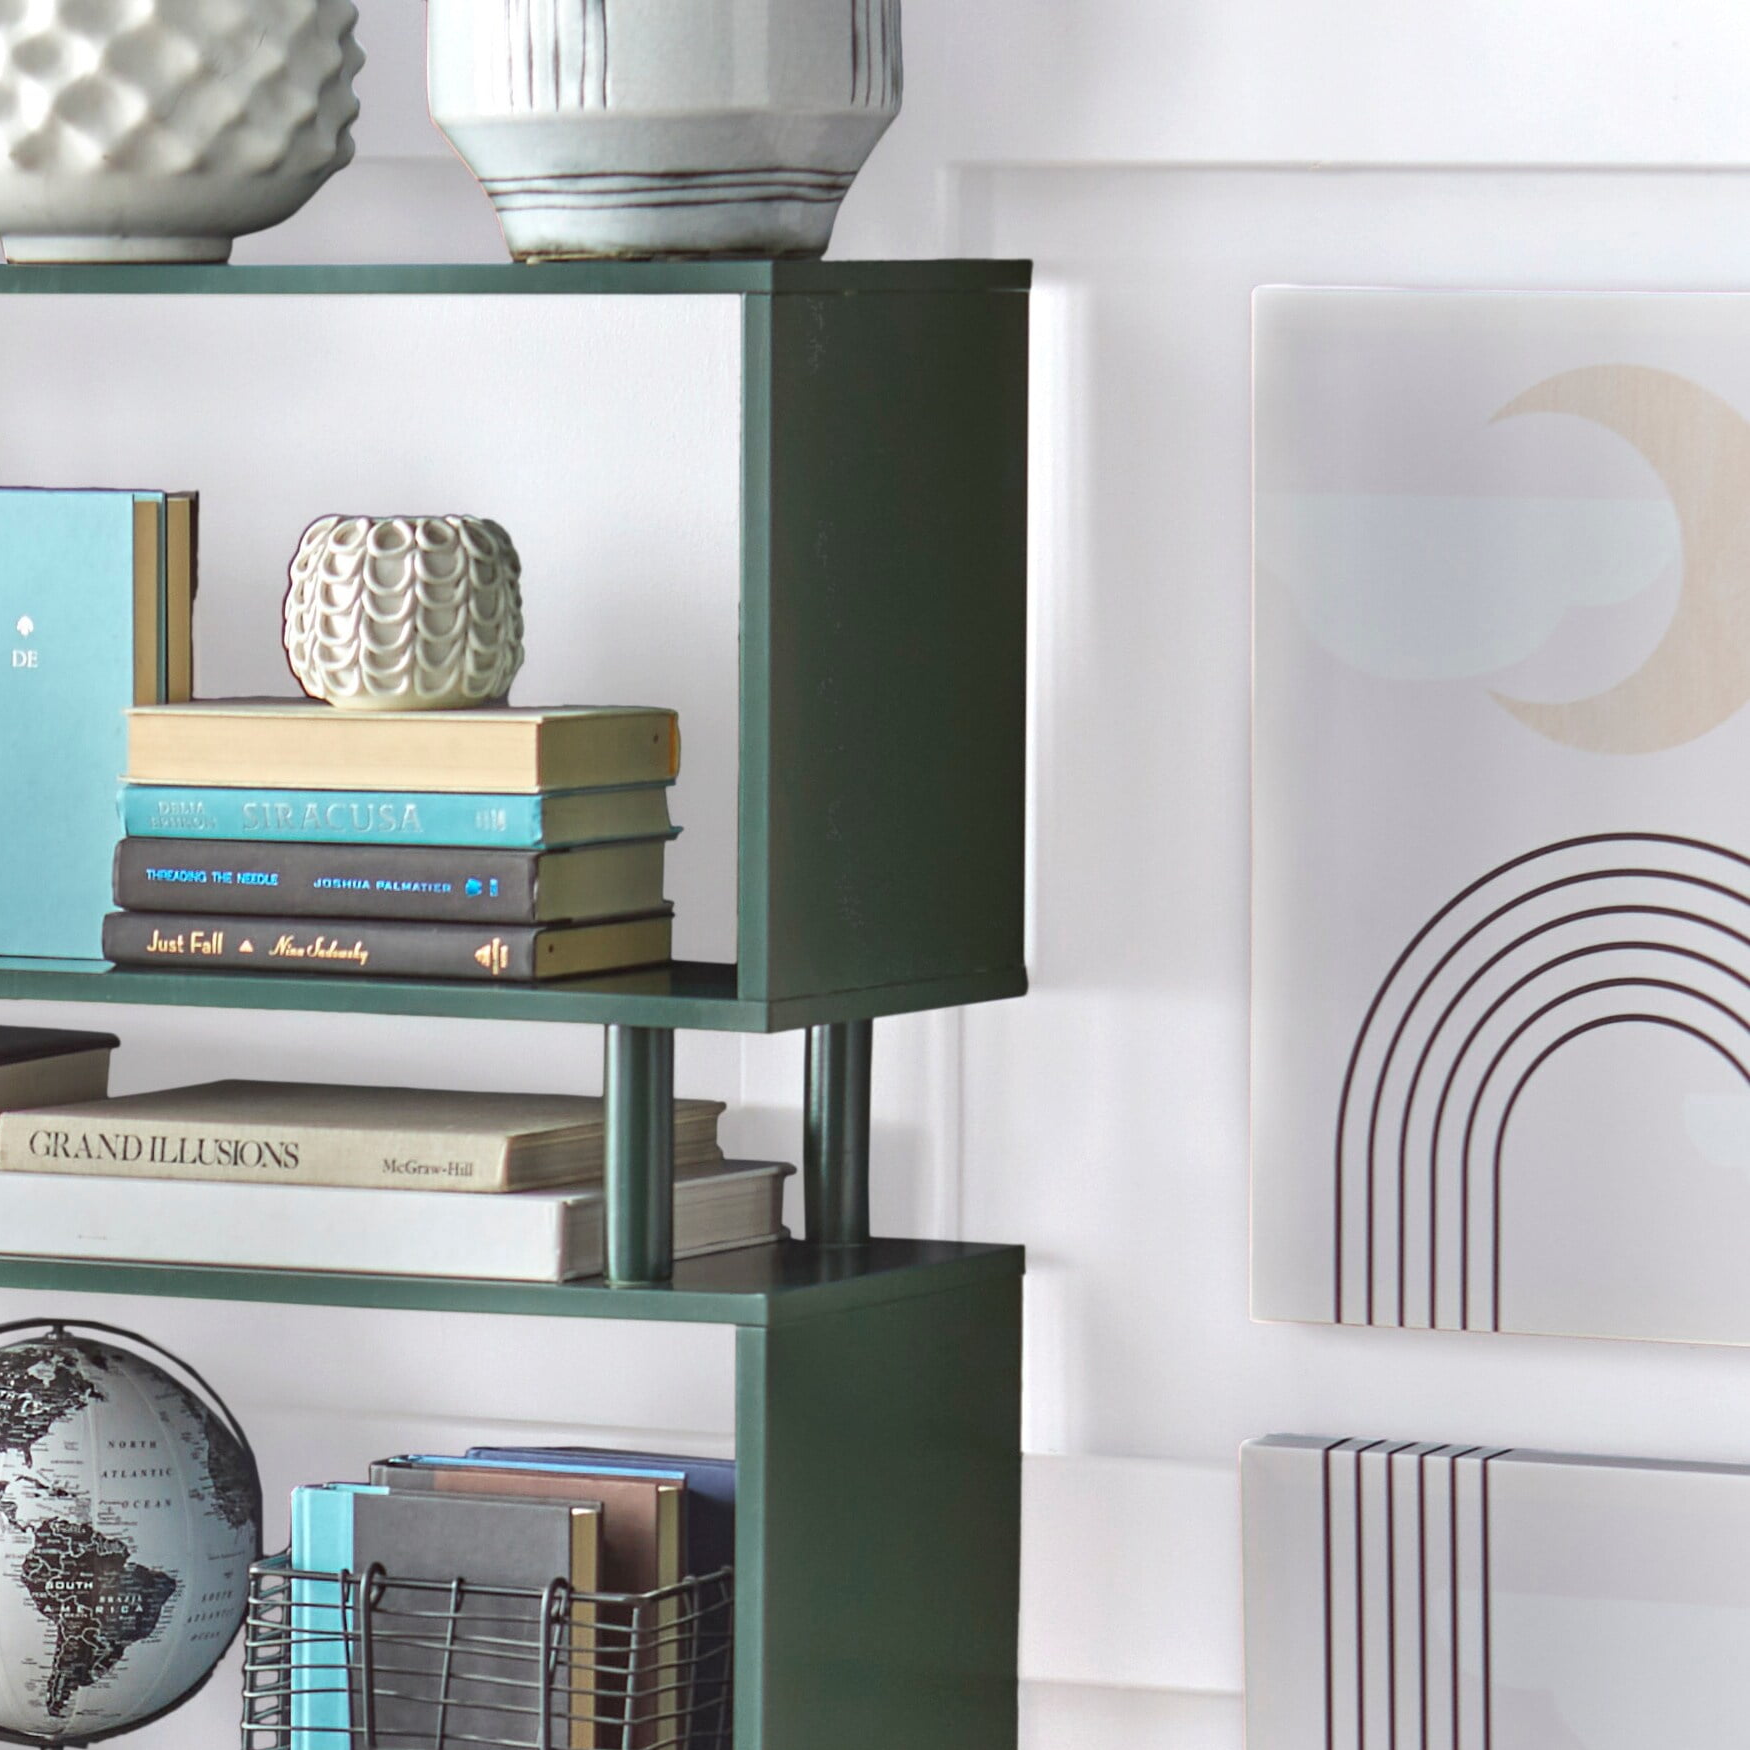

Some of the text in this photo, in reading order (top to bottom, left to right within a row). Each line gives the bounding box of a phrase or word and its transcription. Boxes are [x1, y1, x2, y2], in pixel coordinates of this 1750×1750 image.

[11, 650, 39, 668] DE
[242, 802, 424, 833] SIRACUSA
[146, 868, 279, 887] THREADING THE NEEDLE
[313, 877, 452, 894] JOSHUA PALMATIER
[147, 929, 223, 955] Just Fall
[29, 1130, 300, 1170] GRAND ILLUSIONS
[382, 1158, 474, 1177] McGraw-Hill
[107, 1440, 158, 1448] NORTH
[100, 1468, 173, 1478] ATLANTIC
[121, 1499, 173, 1508] OCEAN
[45, 1581, 94, 1590] SOUTH
[43, 1604, 144, 1614] AMERICA
